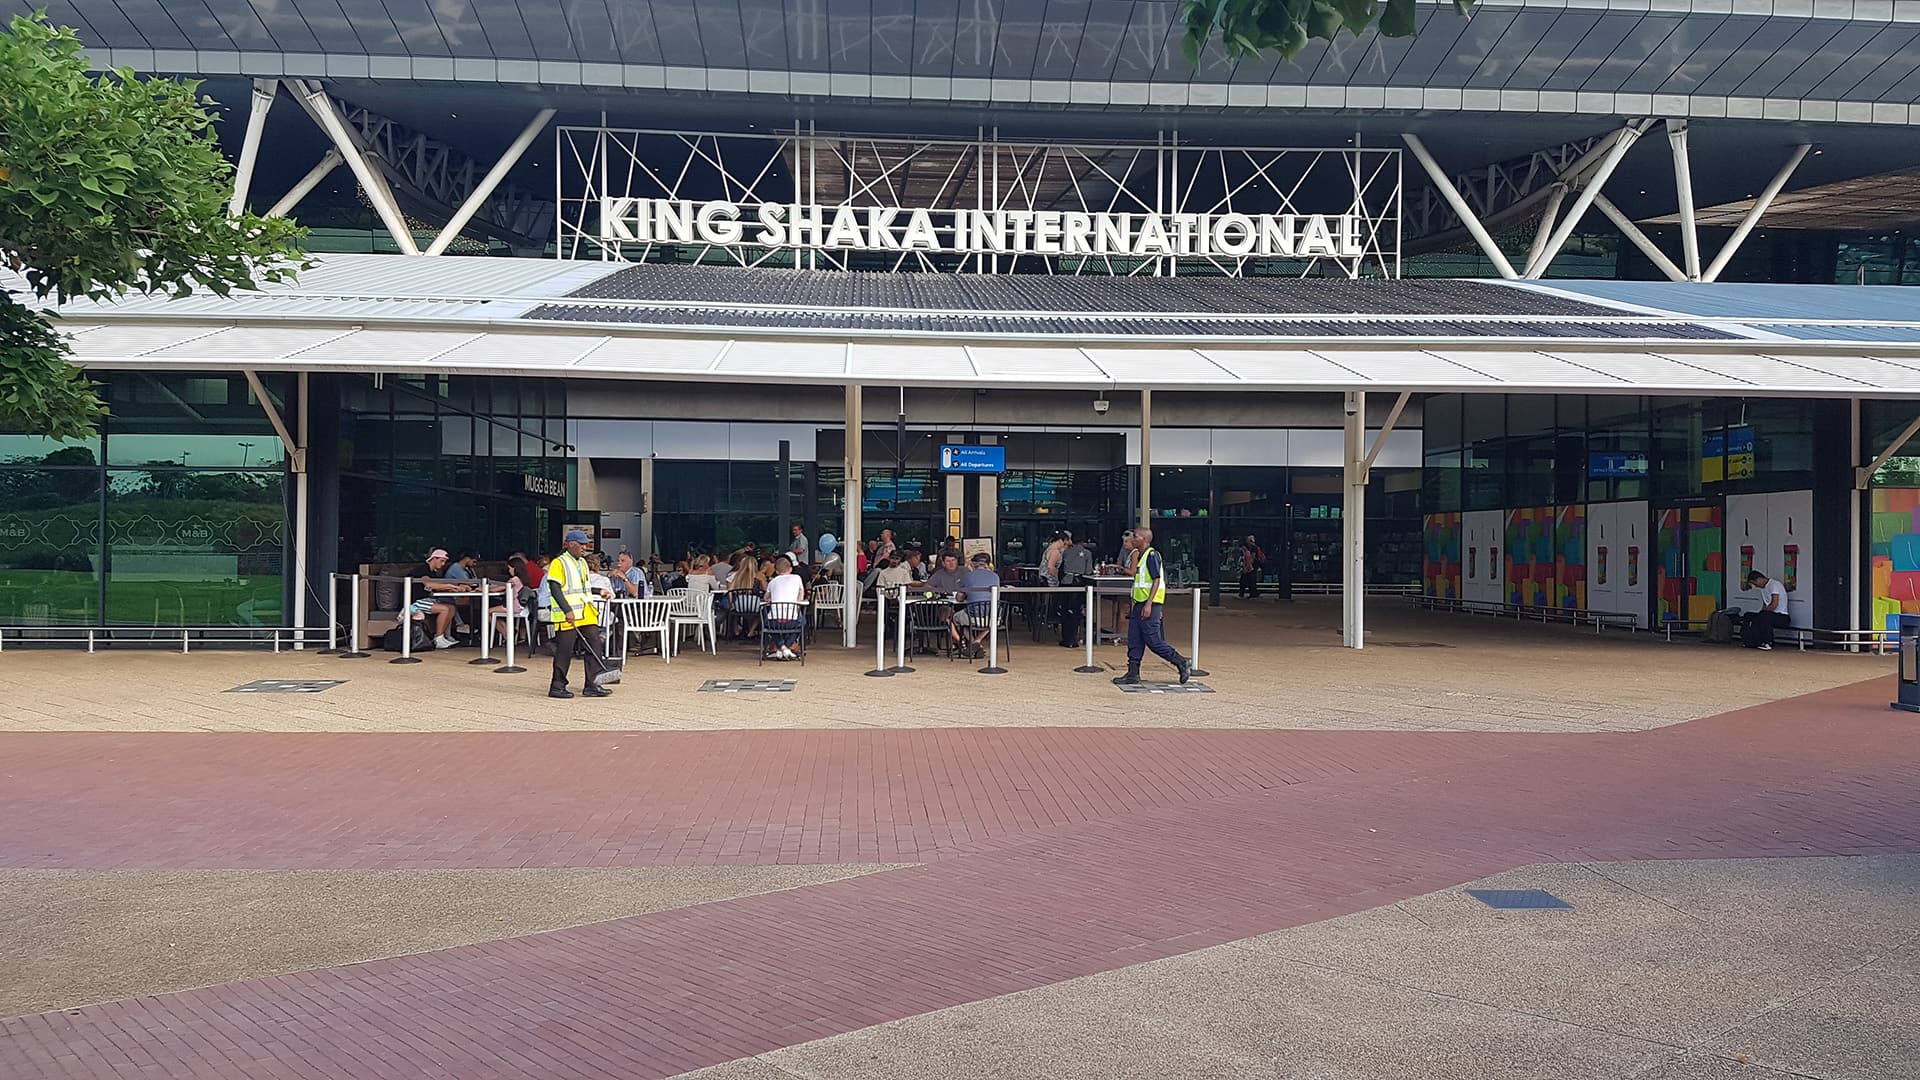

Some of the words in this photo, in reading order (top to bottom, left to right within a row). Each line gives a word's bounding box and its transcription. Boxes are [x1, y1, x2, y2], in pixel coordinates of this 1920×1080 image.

[600, 198, 743, 246] KING
[756, 202, 941, 250] SHAKA
[955, 209, 1362, 257] INTERNATIONAL
[525, 473, 543, 493] MUGG
[544, 479, 549, 494] &
[549, 480, 565, 497] BEAN
[0, 529, 26, 537] M&B
[182, 529, 208, 538] M&B
